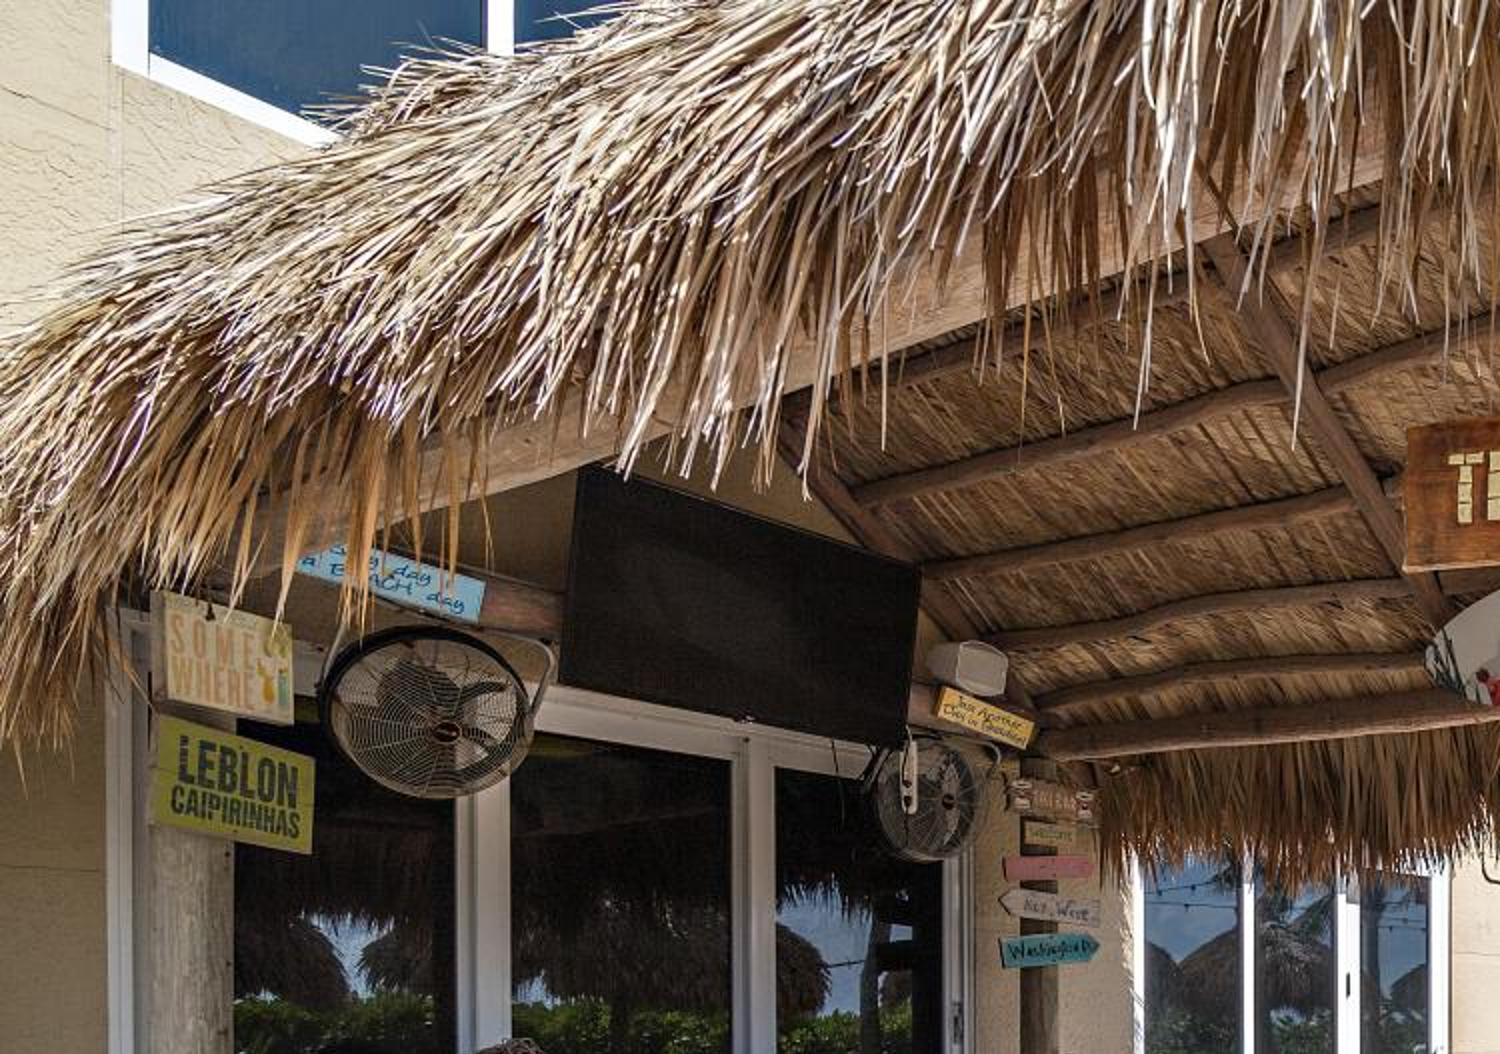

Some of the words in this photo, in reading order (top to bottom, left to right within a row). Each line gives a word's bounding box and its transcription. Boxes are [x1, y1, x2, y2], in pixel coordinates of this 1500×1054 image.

[169, 611, 255, 671] SOME
[171, 655, 258, 711] WHERE
[177, 735, 299, 808] LEBLON
[171, 784, 301, 838] CAIPIRINHAS
